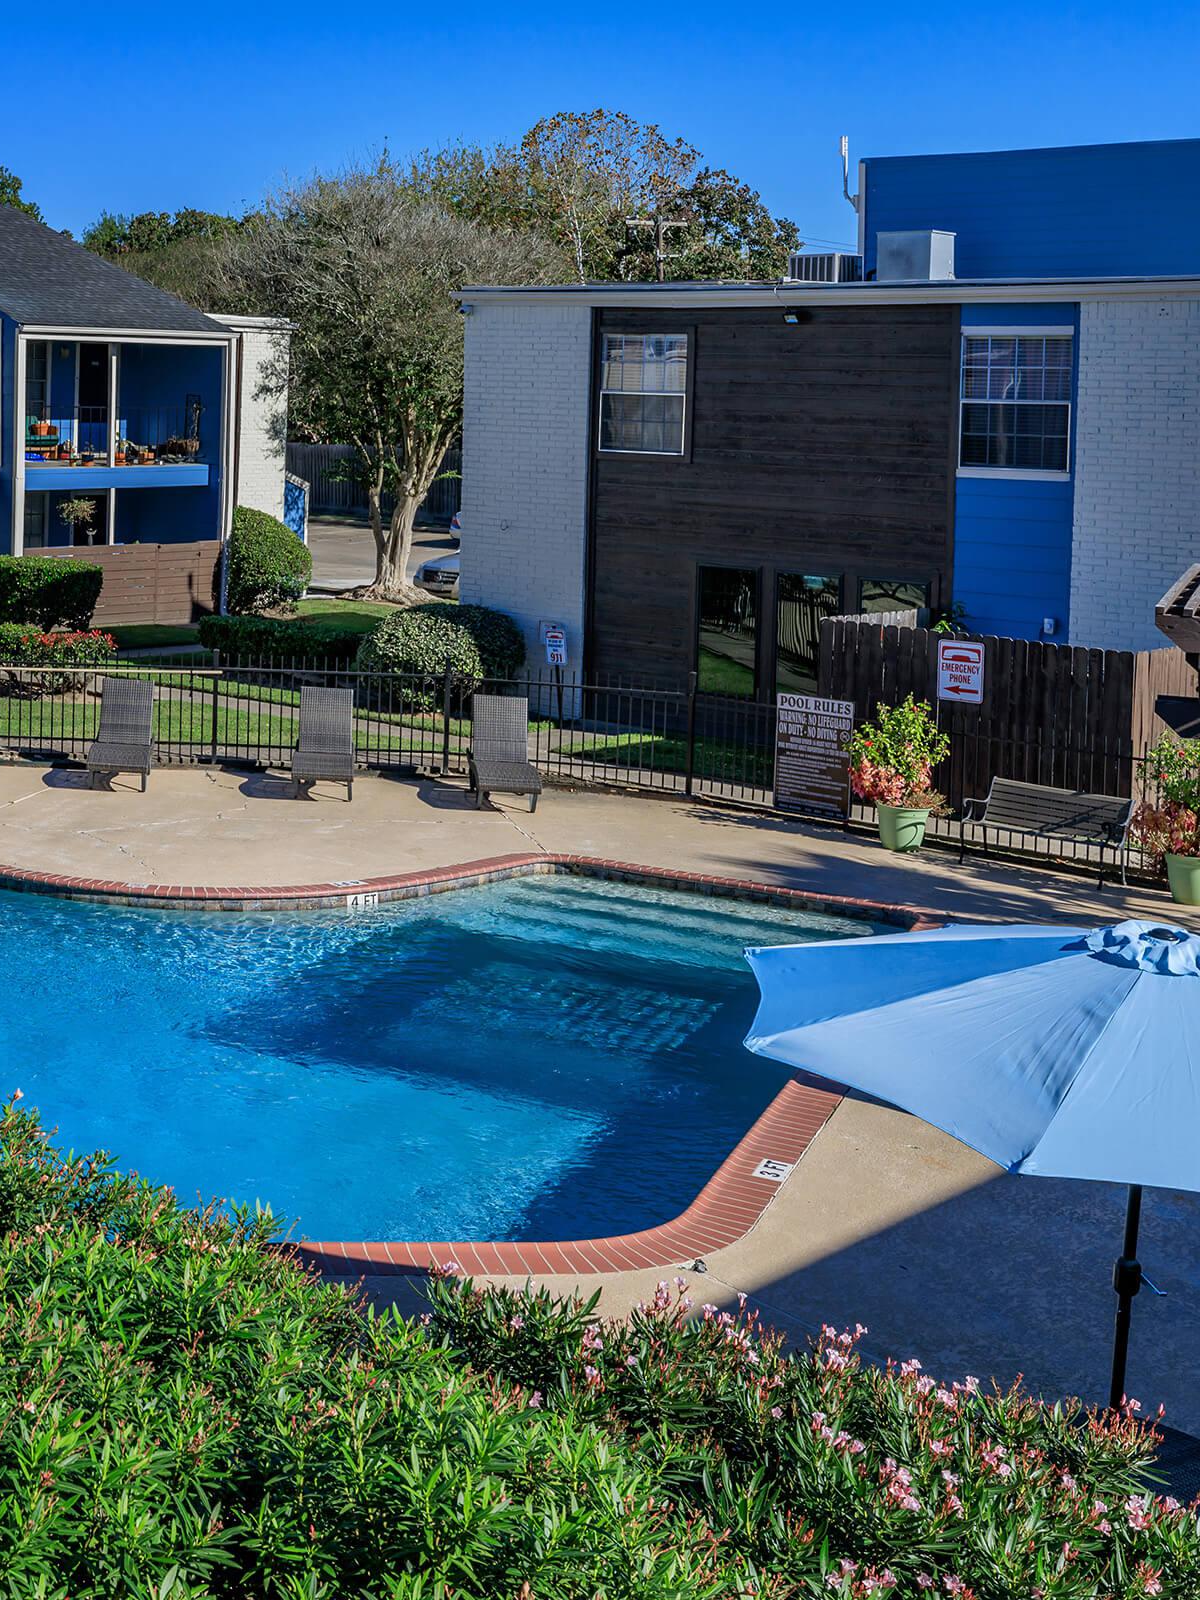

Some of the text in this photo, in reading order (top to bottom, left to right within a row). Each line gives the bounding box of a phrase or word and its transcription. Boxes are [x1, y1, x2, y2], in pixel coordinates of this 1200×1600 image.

[550, 652, 563, 663] 911
[942, 662, 981, 675] EMERGENCY
[949, 673, 971, 684] PHONE
[780, 695, 851, 715] POOL RULES
[808, 714, 817, 726] NO
[818, 715, 851, 730] LIFEGUARD
[778, 721, 787, 733] ON
[788, 723, 803, 736] DUTY
[807, 726, 816, 738] NO
[816, 728, 838, 741] DIVING
[351, 894, 377, 905] 4 FT
[763, 1160, 788, 1172] FT
